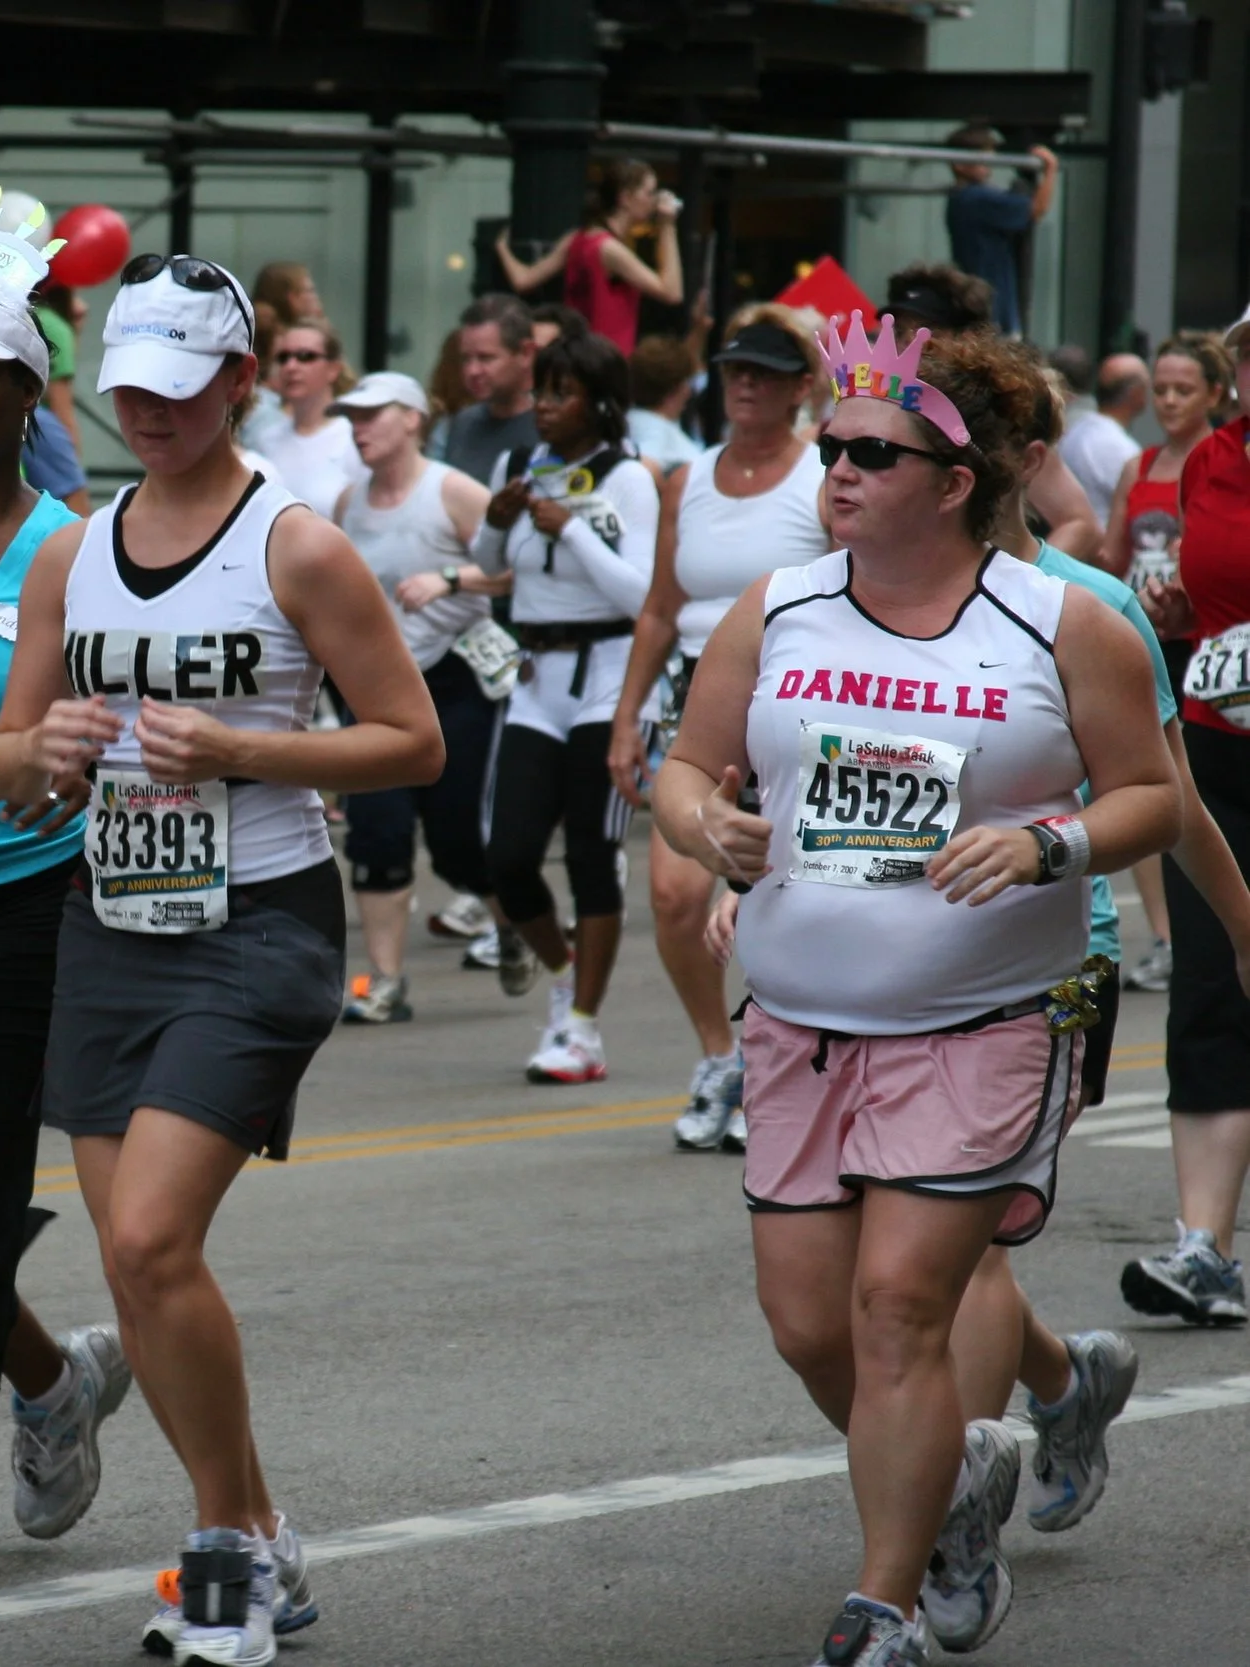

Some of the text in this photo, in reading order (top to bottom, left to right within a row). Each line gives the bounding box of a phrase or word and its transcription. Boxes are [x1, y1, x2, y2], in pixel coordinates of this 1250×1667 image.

[776, 669, 1008, 722] DANIELLE
[849, 740, 897, 758] LaSalle
[118, 784, 200, 799] LaSalle Bank
[806, 762, 948, 831] 45522
[93, 809, 215, 873] 33393
[816, 834, 937, 848] 30th ANNIVERSARY
[804, 861, 831, 871] October
[840, 864, 858, 874] 2007
[127, 873, 214, 892] ANNIVERSARY
